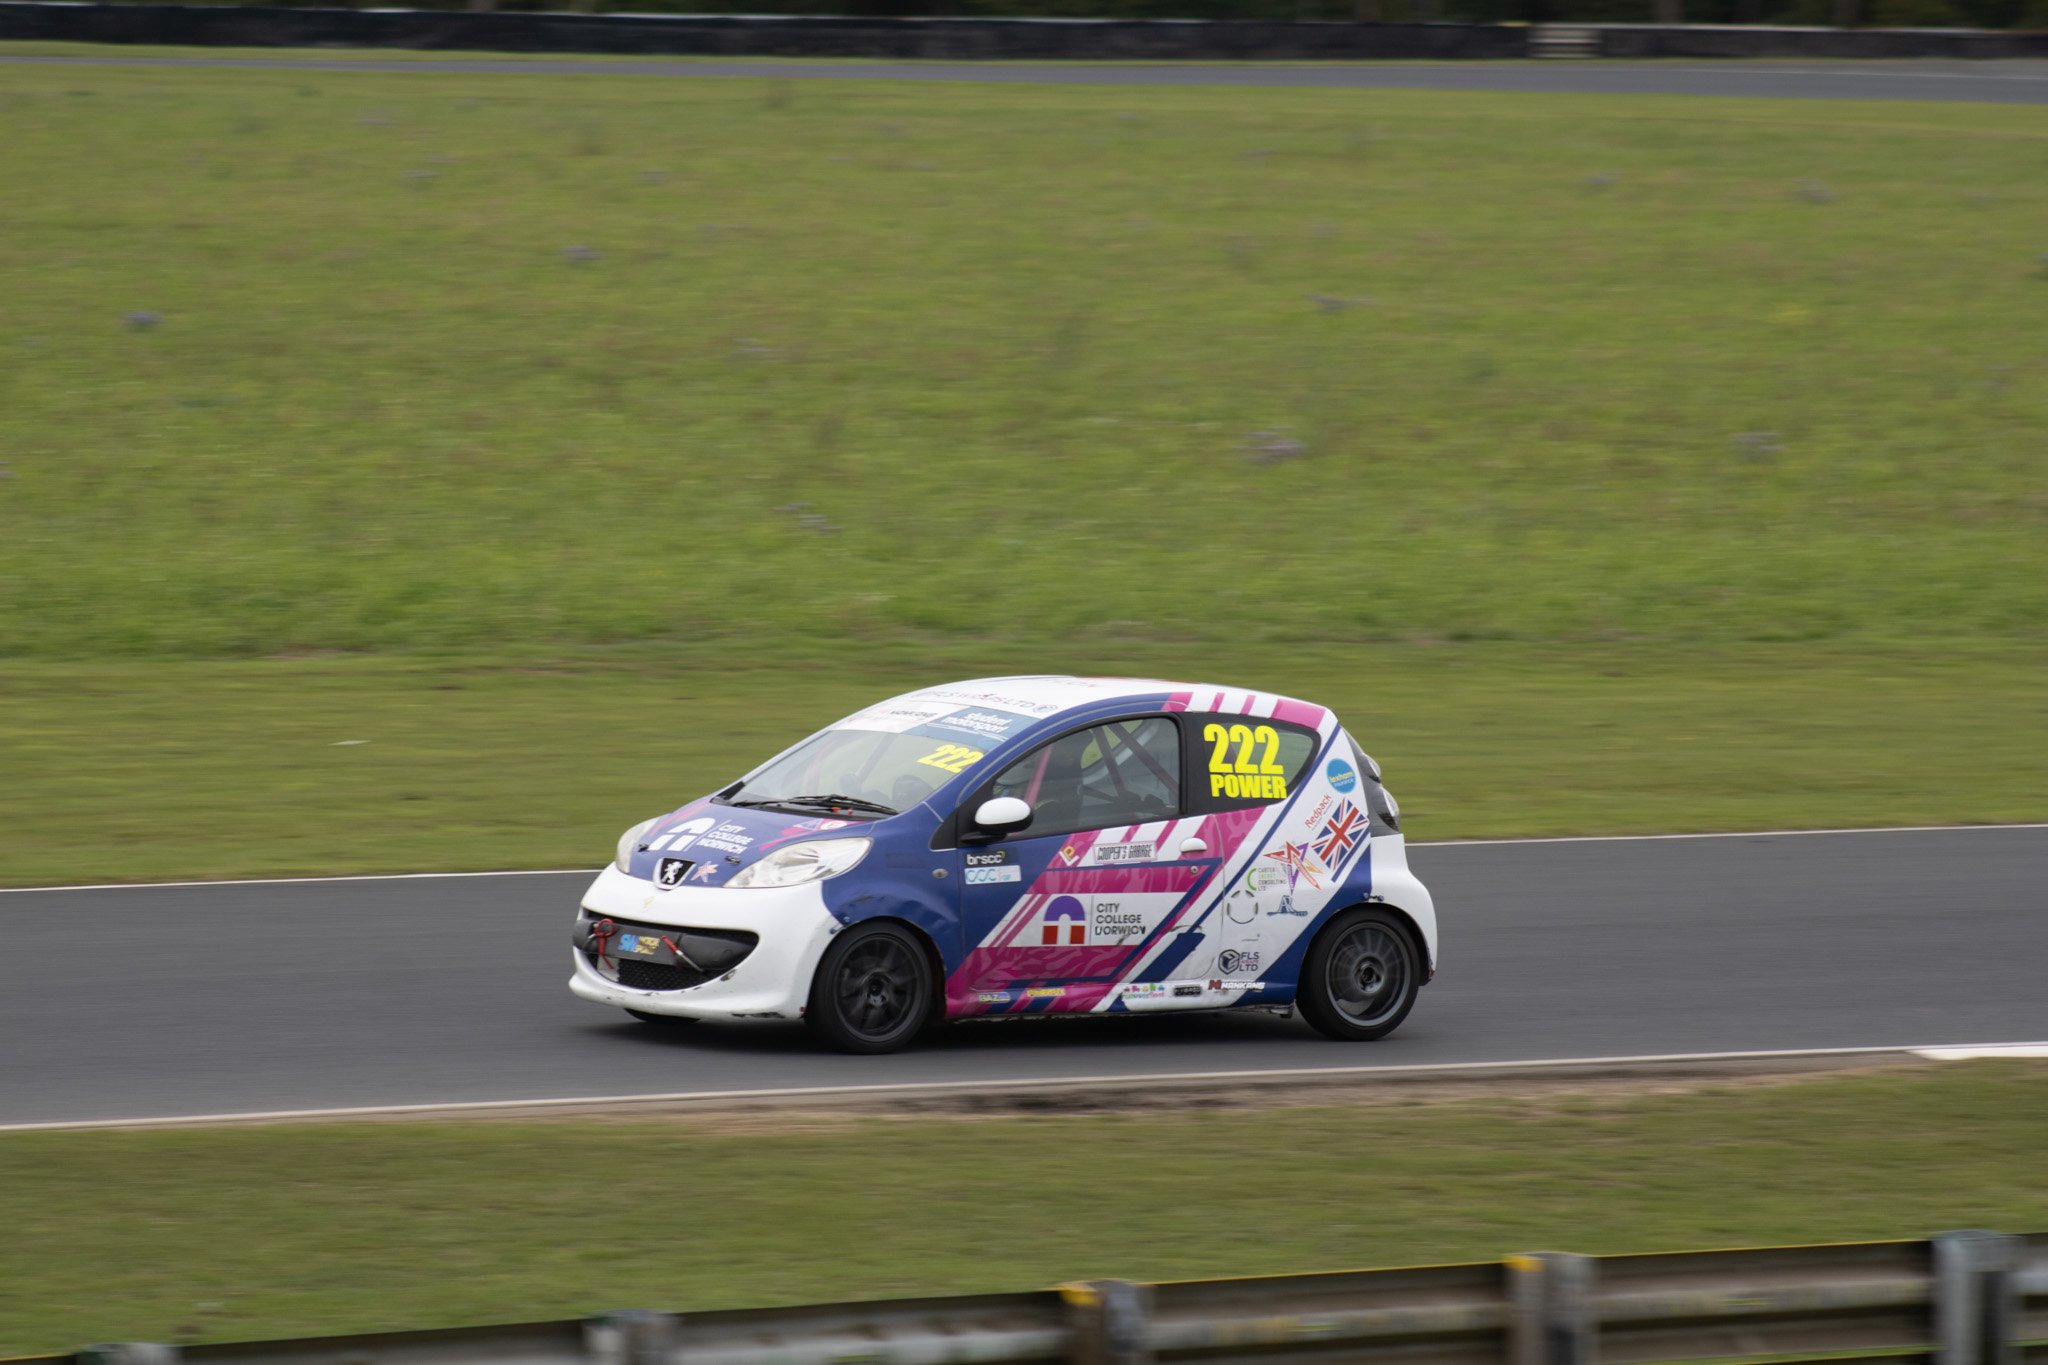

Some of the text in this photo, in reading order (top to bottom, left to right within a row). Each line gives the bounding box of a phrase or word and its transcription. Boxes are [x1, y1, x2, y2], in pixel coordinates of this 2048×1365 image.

[1002, 697, 1037, 708] LTD
[941, 716, 1010, 733] motorsport
[964, 712, 1012, 725] student
[1203, 723, 1285, 775] 222
[917, 744, 984, 773] 222
[1328, 771, 1354, 783] lexham
[1210, 774, 1287, 799] POWER
[1304, 792, 1332, 829] Redpack
[718, 824, 747, 833] CITY
[706, 830, 754, 846] COLLEGE
[696, 837, 748, 855] NORWICH
[966, 853, 1003, 866] brscc
[1096, 902, 1121, 914] CITY
[1095, 914, 1143, 925] COLLEGE
[1240, 951, 1260, 961] FLS
[1239, 964, 1259, 972] LTD
[1221, 981, 1266, 991] NANKANG
